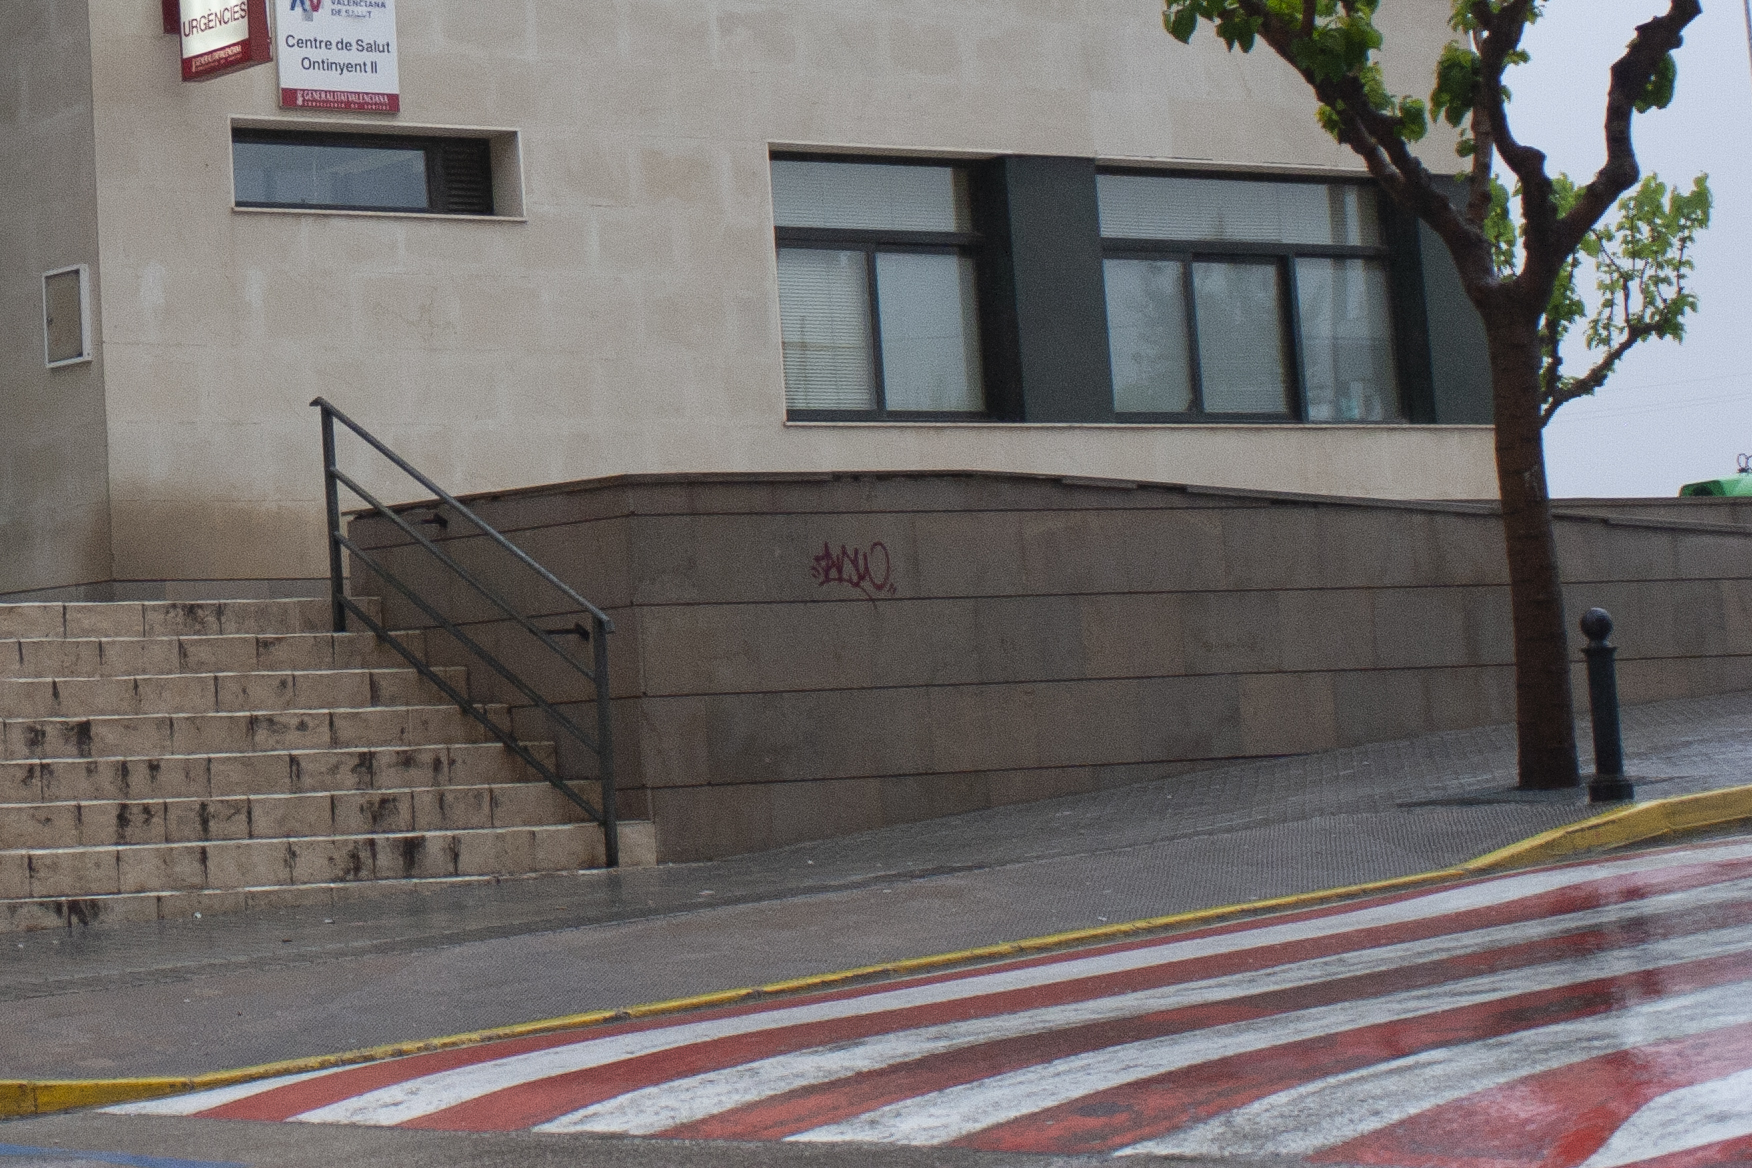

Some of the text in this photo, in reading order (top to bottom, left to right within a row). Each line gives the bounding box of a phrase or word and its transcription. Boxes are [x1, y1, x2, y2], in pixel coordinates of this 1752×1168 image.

[182, 1, 247, 38] URGÈNCIES
[331, 8, 342, 17] DE
[285, 34, 391, 53] Centre de Salut
[301, 57, 378, 75] Ontinyent II
